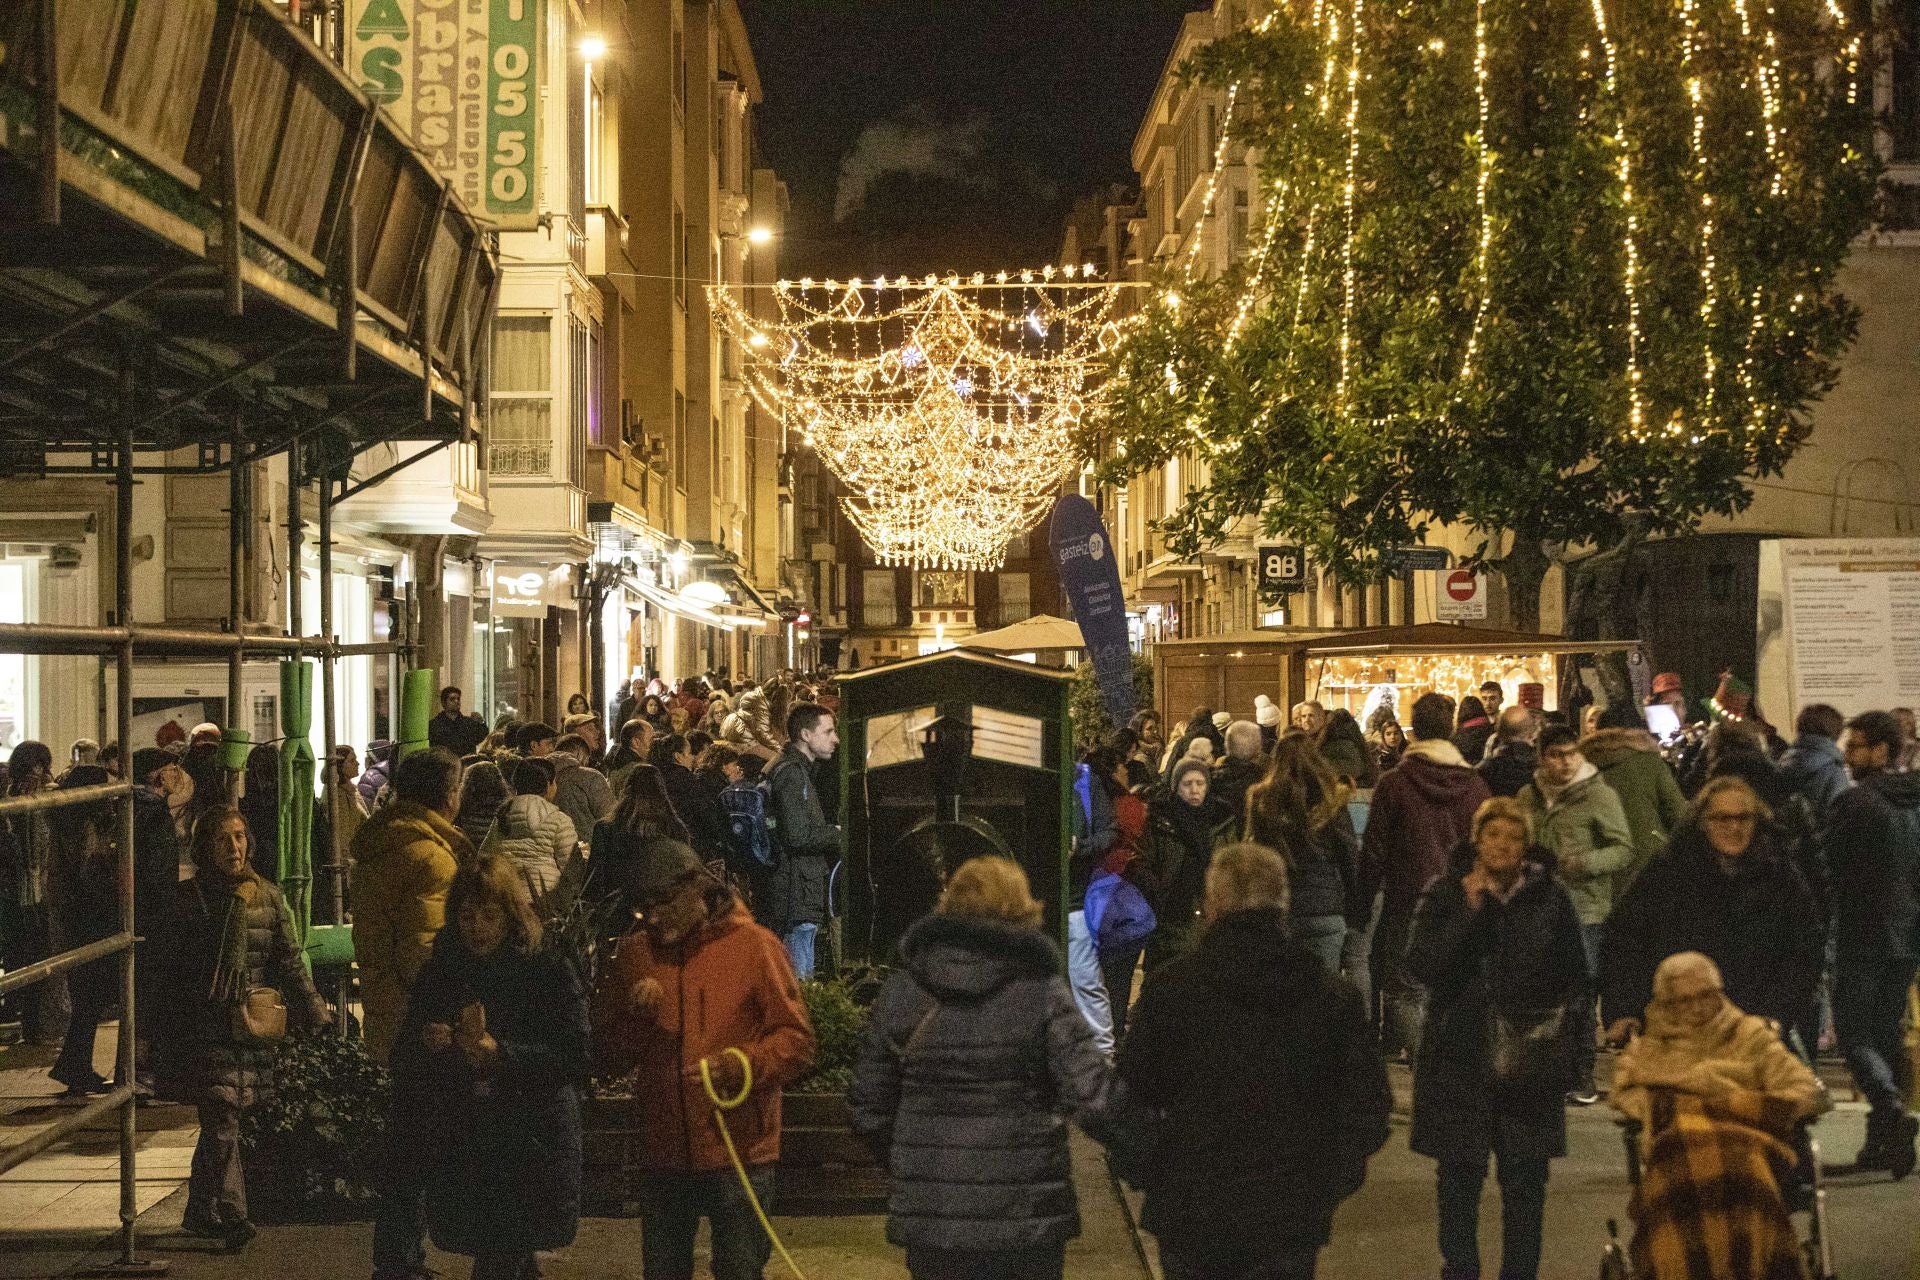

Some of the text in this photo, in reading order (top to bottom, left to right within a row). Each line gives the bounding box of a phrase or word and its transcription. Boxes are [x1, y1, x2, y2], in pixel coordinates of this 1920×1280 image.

[415, 0, 459, 147] bras
[465, 27, 487, 44] y
[459, 56, 481, 208] andamios
